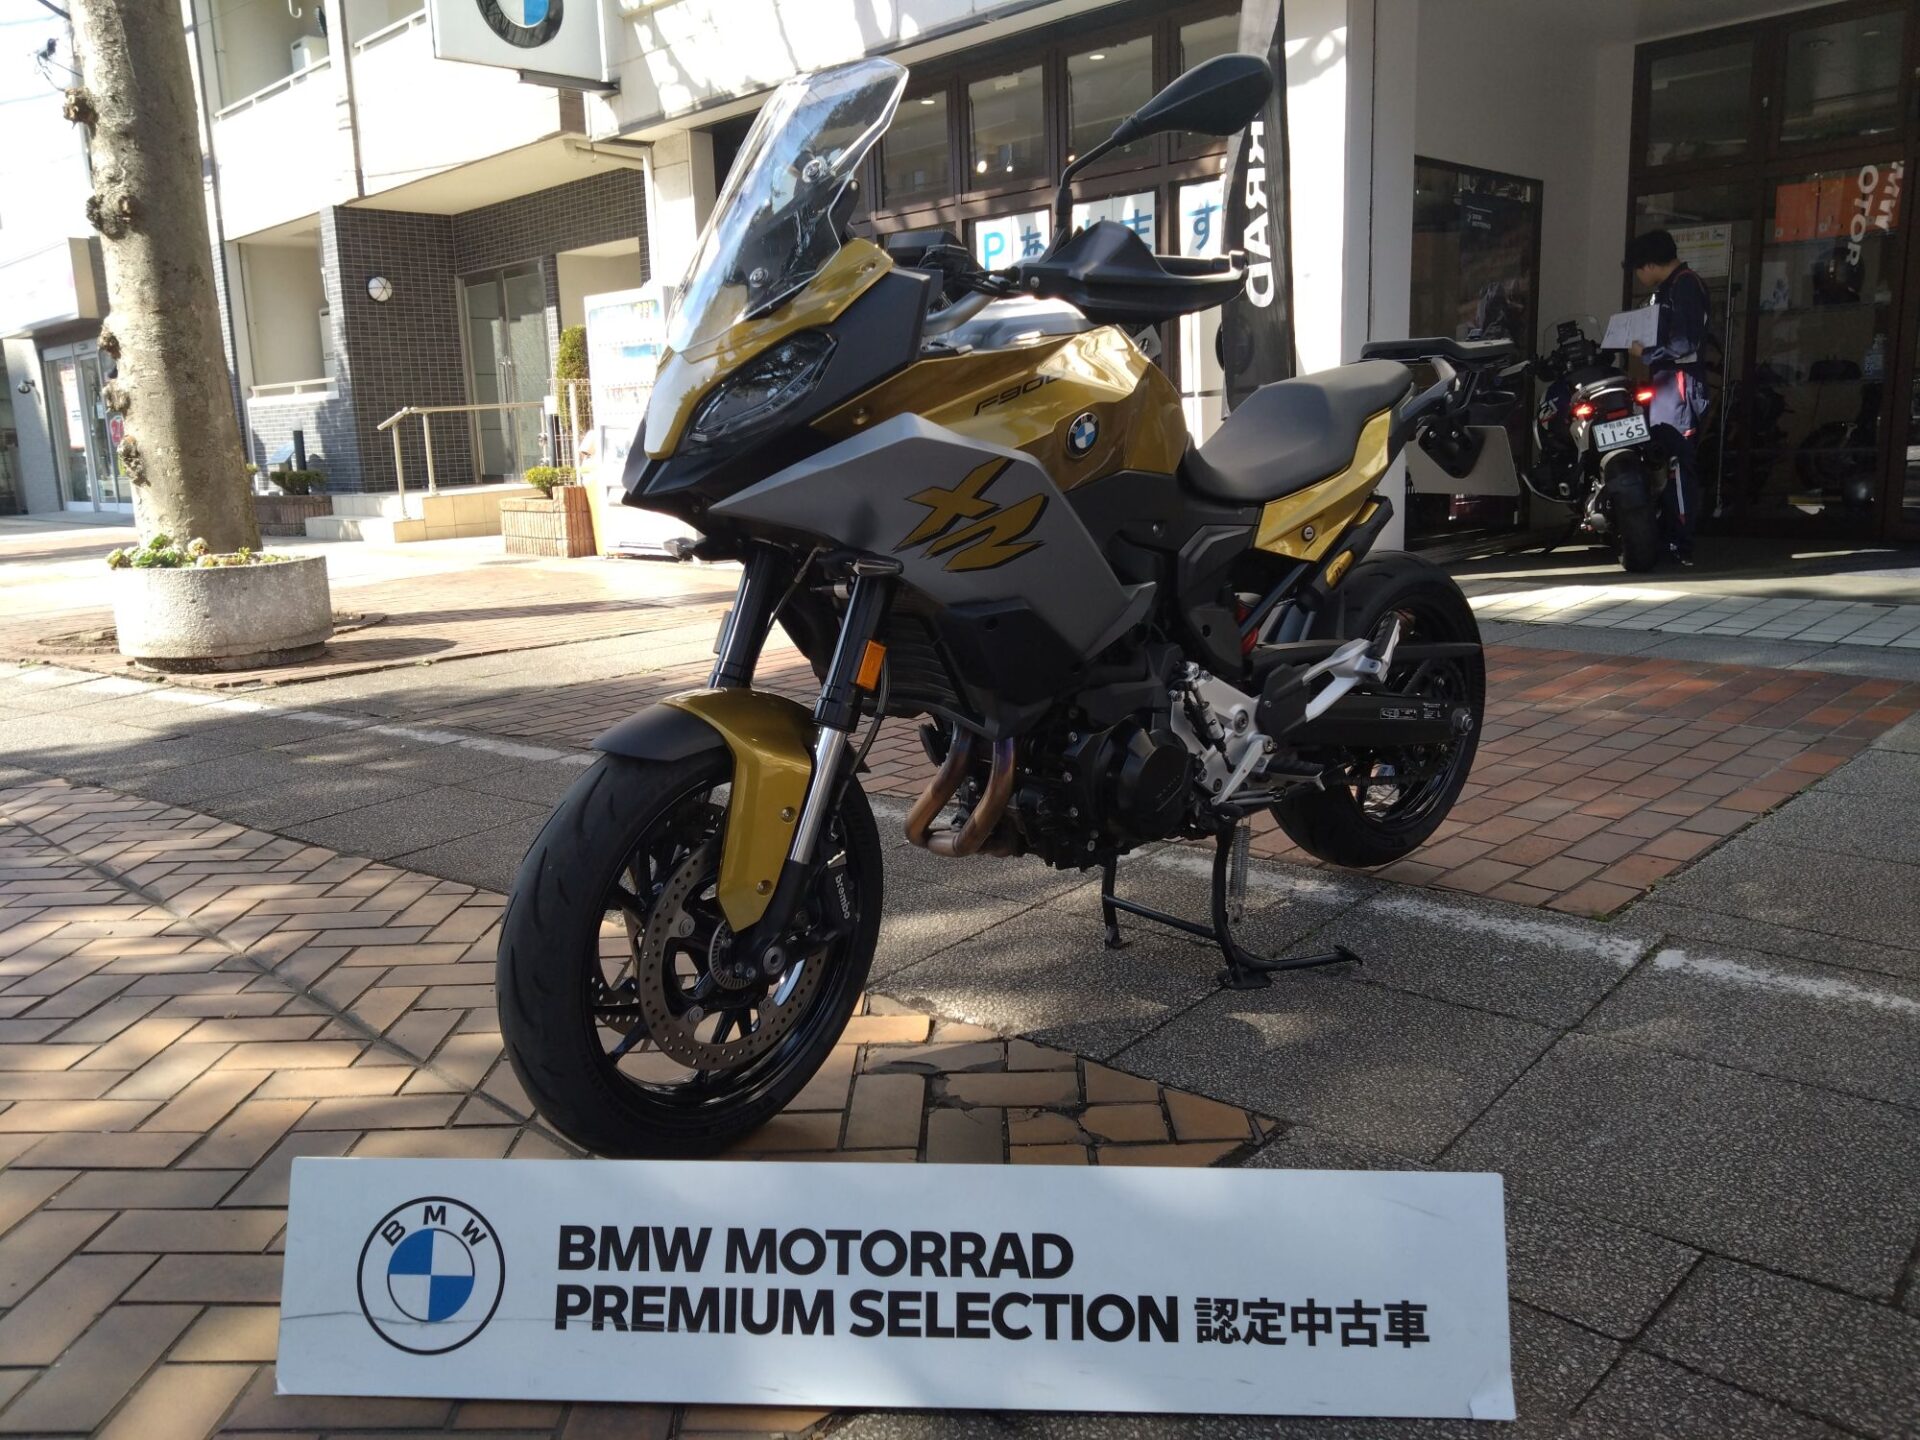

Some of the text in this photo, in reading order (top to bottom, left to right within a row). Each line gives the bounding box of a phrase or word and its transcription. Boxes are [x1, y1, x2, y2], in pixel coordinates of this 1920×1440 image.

[1601, 424, 1645, 445] 11-65
[835, 873, 850, 920] brembo
[381, 1205, 487, 1247] BMW
[558, 1225, 1074, 1280] BMW MOTORRAD
[555, 1284, 1431, 1349] PREMIUM SELECTION 認定中古車
